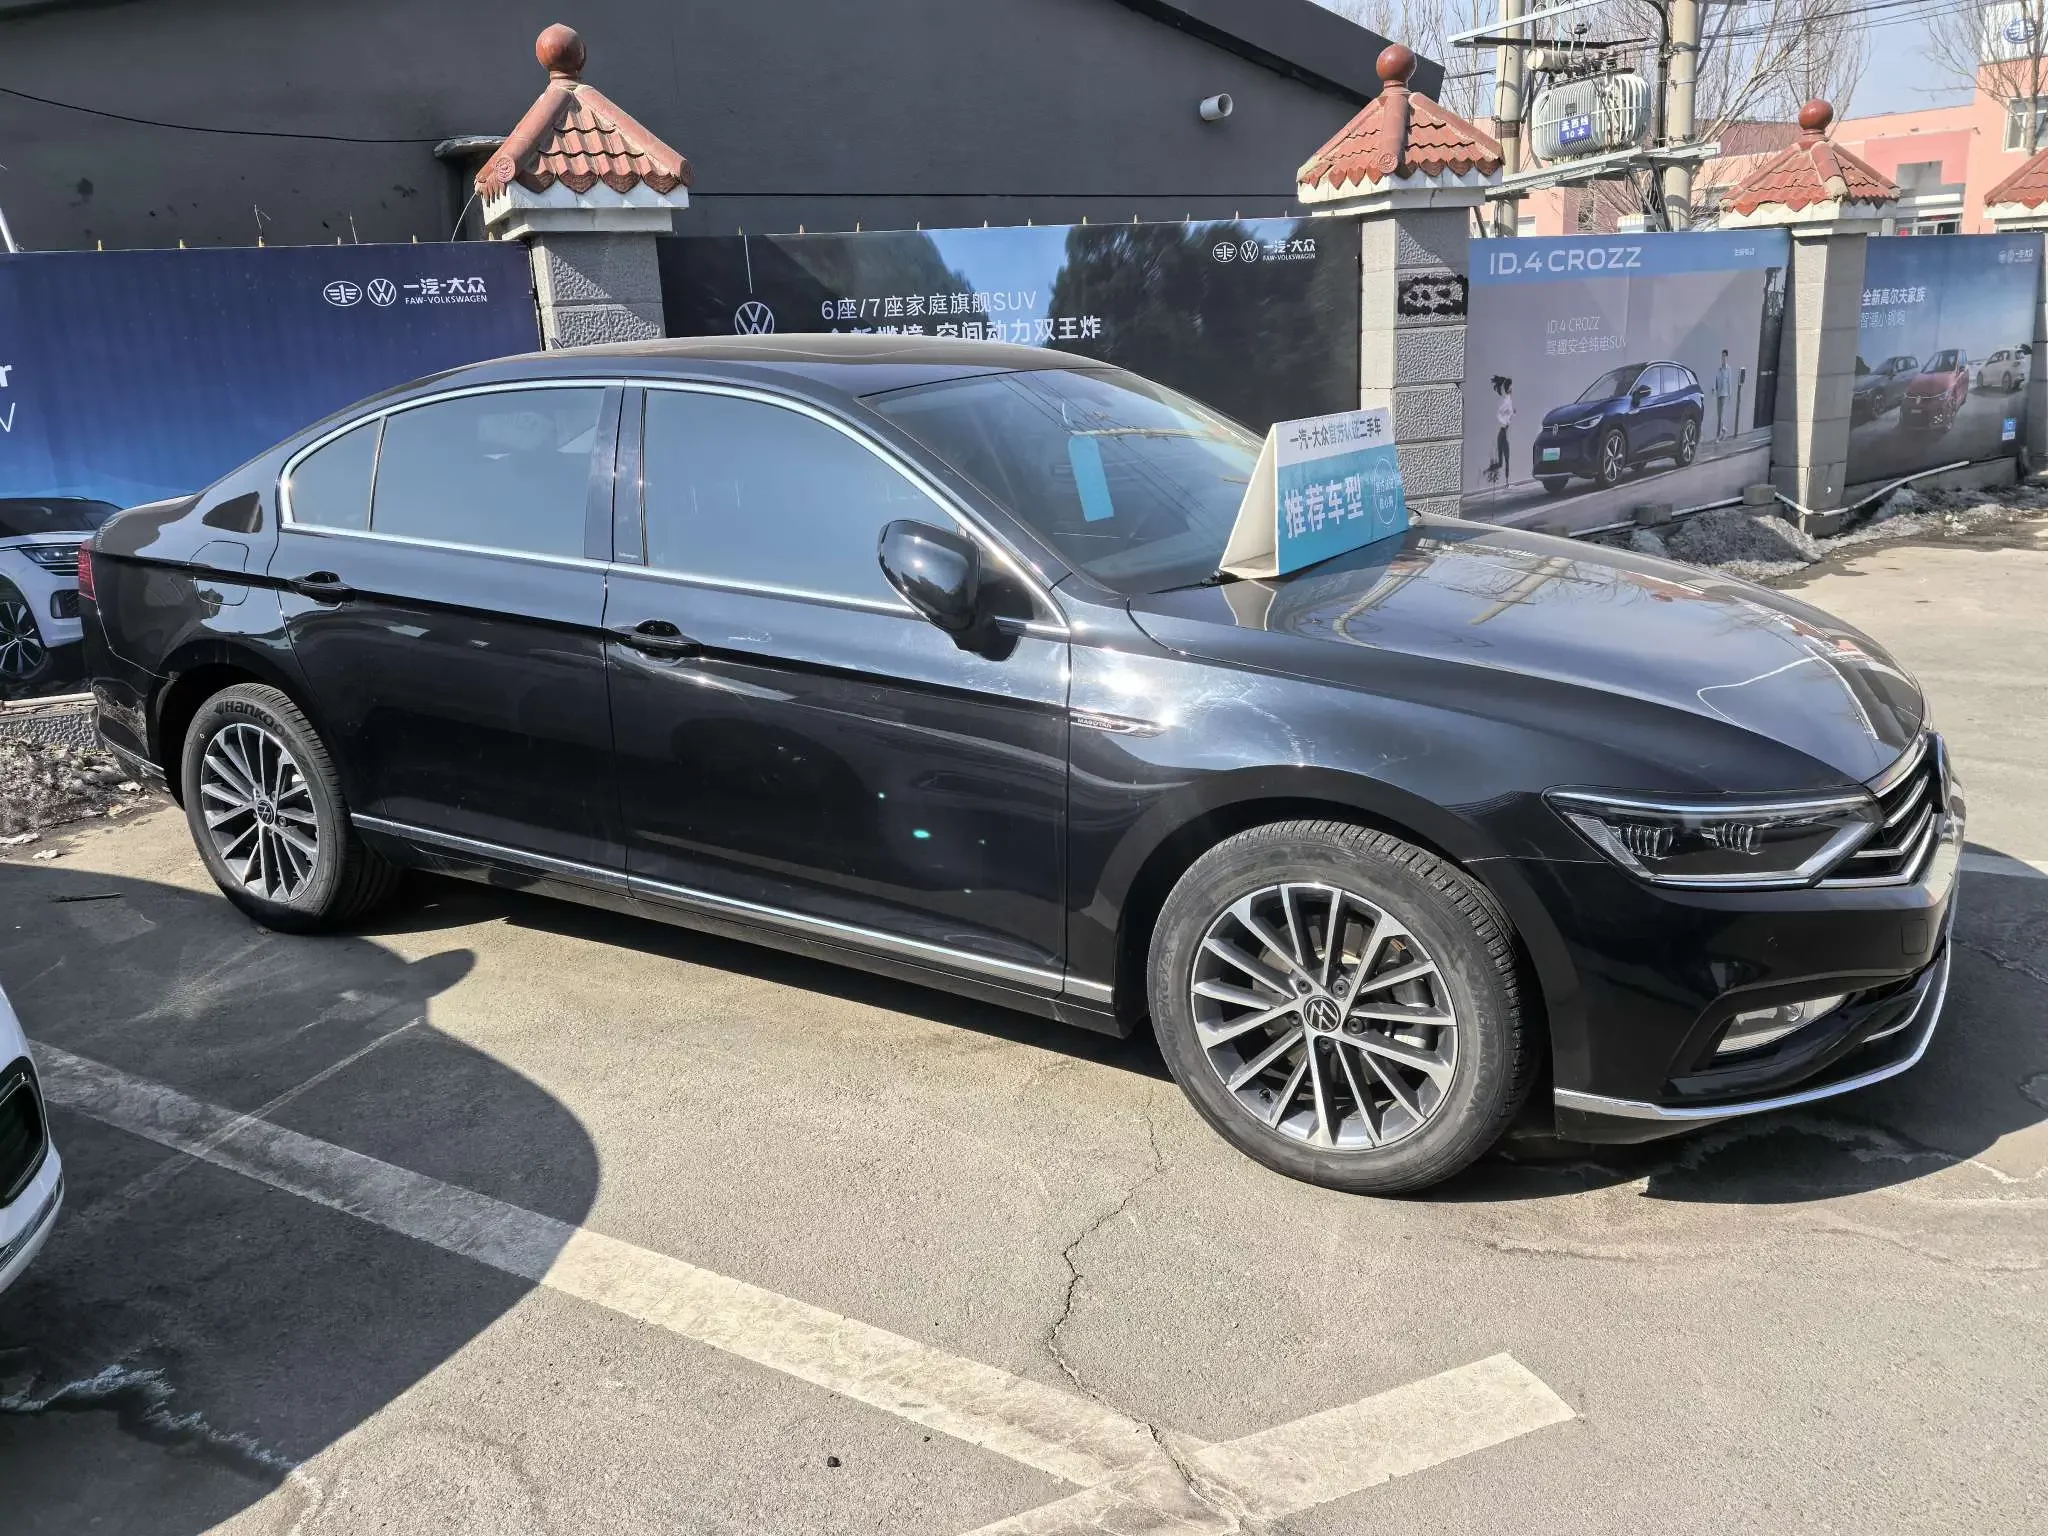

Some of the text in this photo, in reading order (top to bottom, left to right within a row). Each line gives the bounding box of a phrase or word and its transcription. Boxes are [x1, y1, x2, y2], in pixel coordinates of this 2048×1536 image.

[1263, 238, 1316, 254] 一汽-大众
[1263, 252, 1316, 261] FAW-VOLKSWAGEN
[1489, 247, 1642, 275] ID.4 CROZZ
[403, 277, 487, 295] 一汽-大众
[405, 295, 488, 305] FAW-VOLKSWAGEN
[821, 290, 1038, 321] 6座/7座家庭旗舰SUV
[1861, 287, 1927, 306] 全新高尔夫家族
[1284, 473, 1364, 539] 推荐车型
